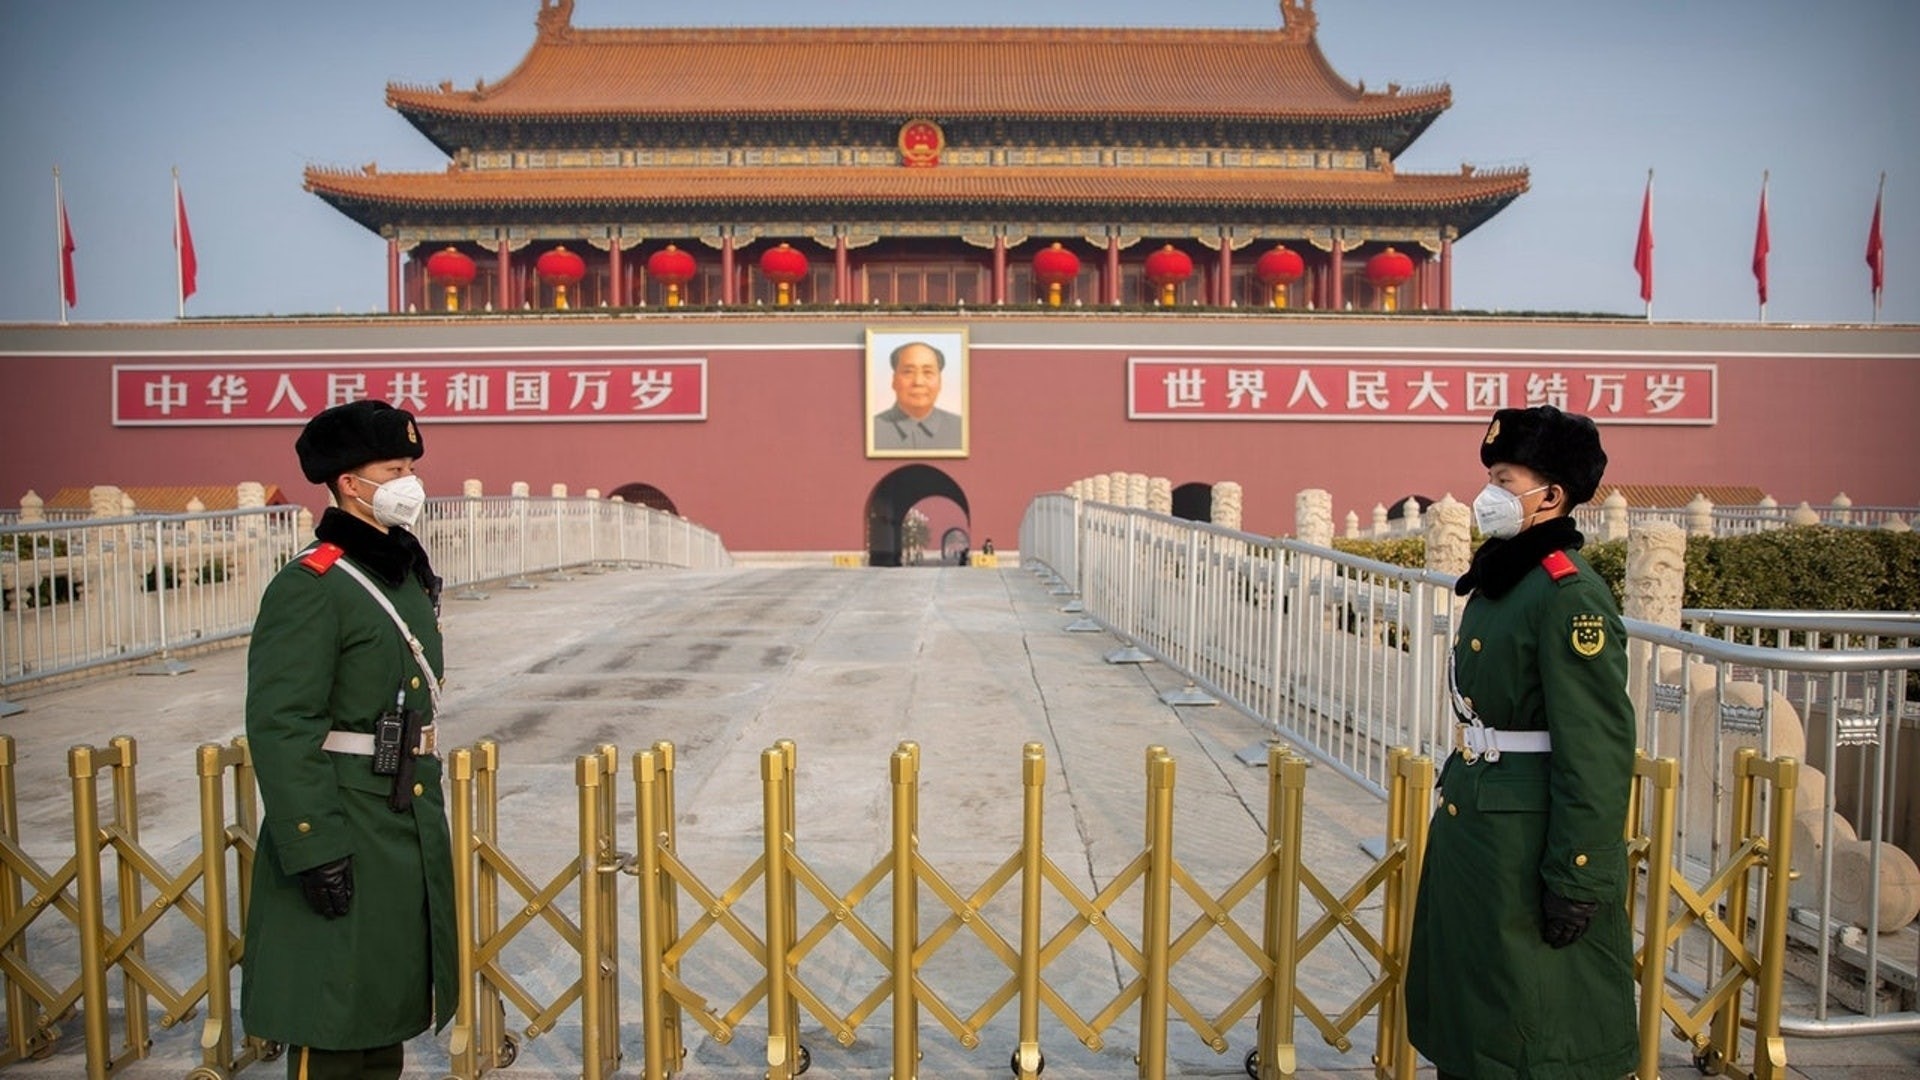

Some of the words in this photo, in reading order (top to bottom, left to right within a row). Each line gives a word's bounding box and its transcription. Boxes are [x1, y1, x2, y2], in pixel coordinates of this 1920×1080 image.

[144, 369, 673, 414] 中华人民共和国万岁
[1162, 368, 1687, 414] 世界人民大团结万岁
